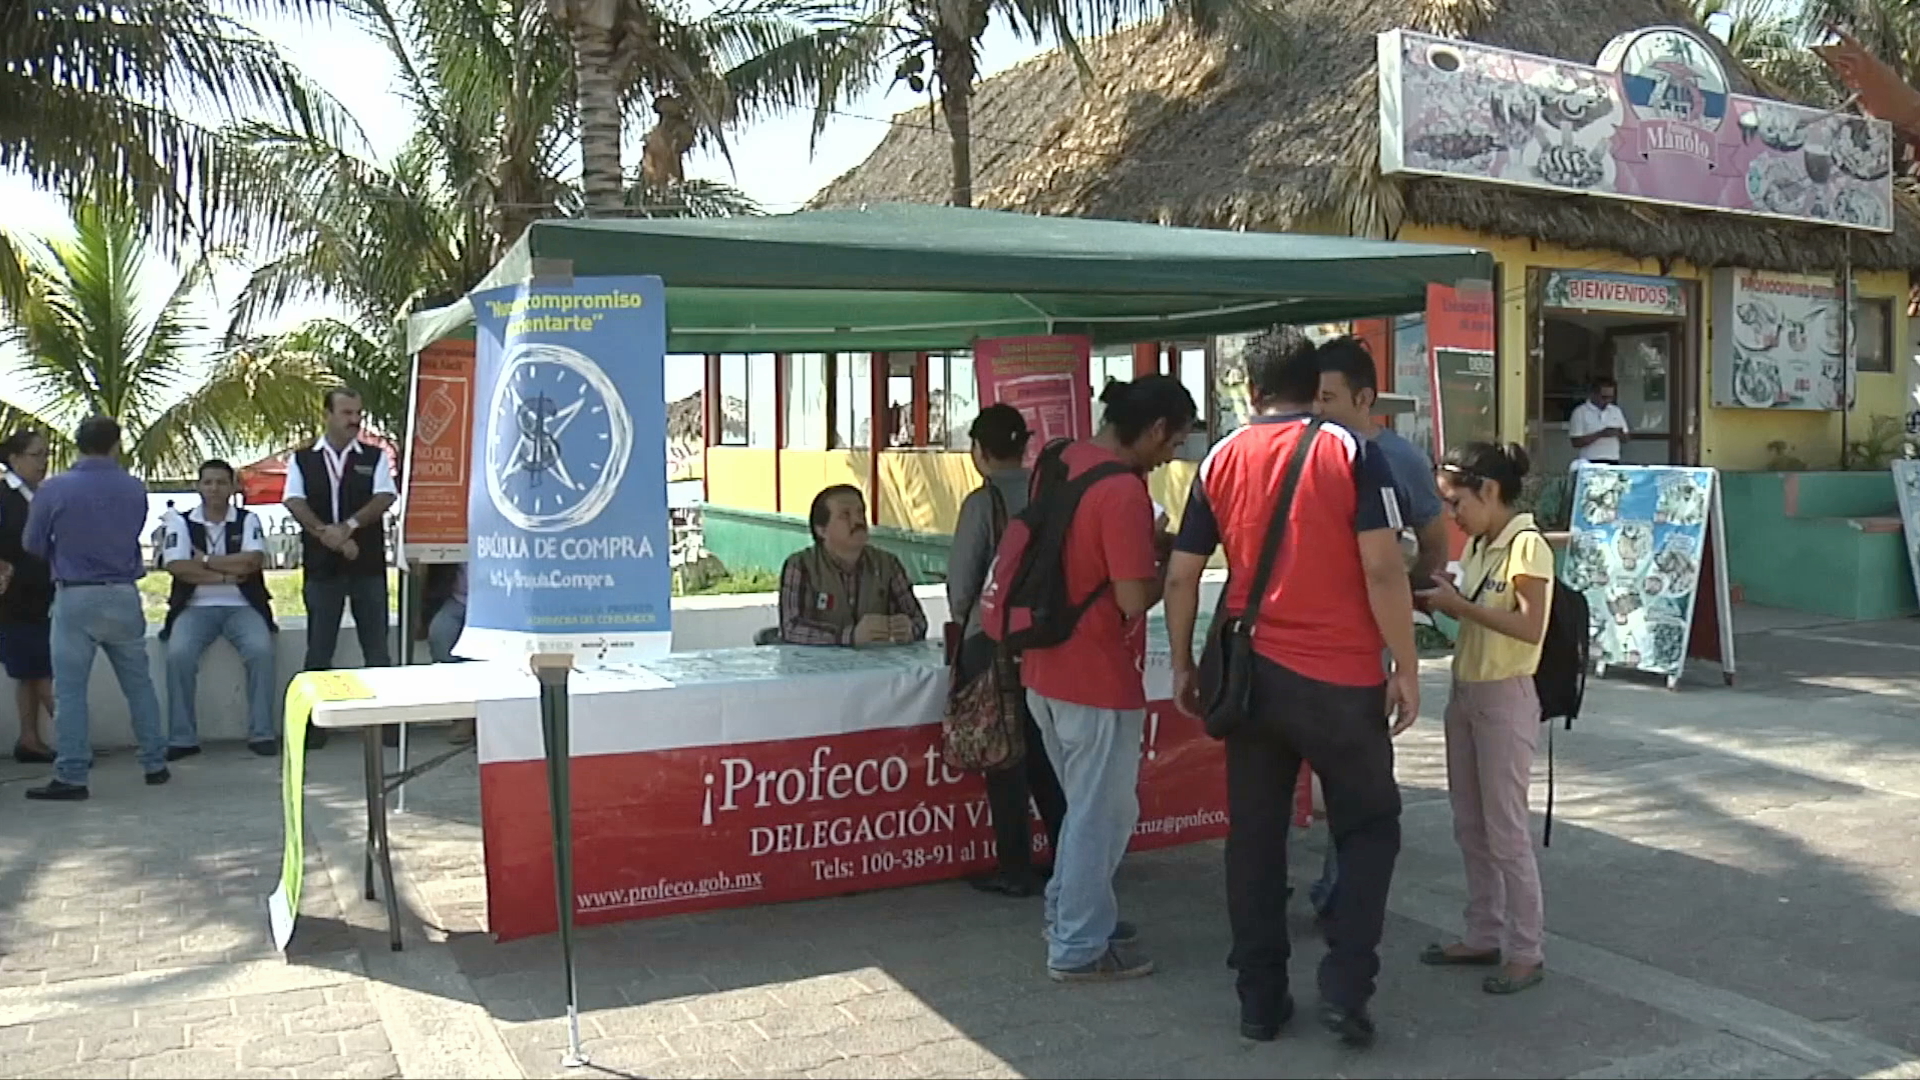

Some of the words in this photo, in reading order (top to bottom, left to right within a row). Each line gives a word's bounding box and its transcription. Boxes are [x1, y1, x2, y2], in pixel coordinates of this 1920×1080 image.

[1646, 126, 1709, 157] Manolo
[526, 289, 642, 311] compromiso
[1568, 279, 1669, 305] BIENVENIDOS
[535, 537, 557, 559] DE
[560, 535, 654, 560] COMPRA
[702, 746, 909, 826] ¡Profeco
[750, 800, 955, 857] DELEGACIÓN
[811, 857, 854, 881] Tels:
[861, 843, 953, 876] 100-38-91
[960, 840, 976, 862] al
[576, 871, 763, 910] www.profeco.gob.mx
